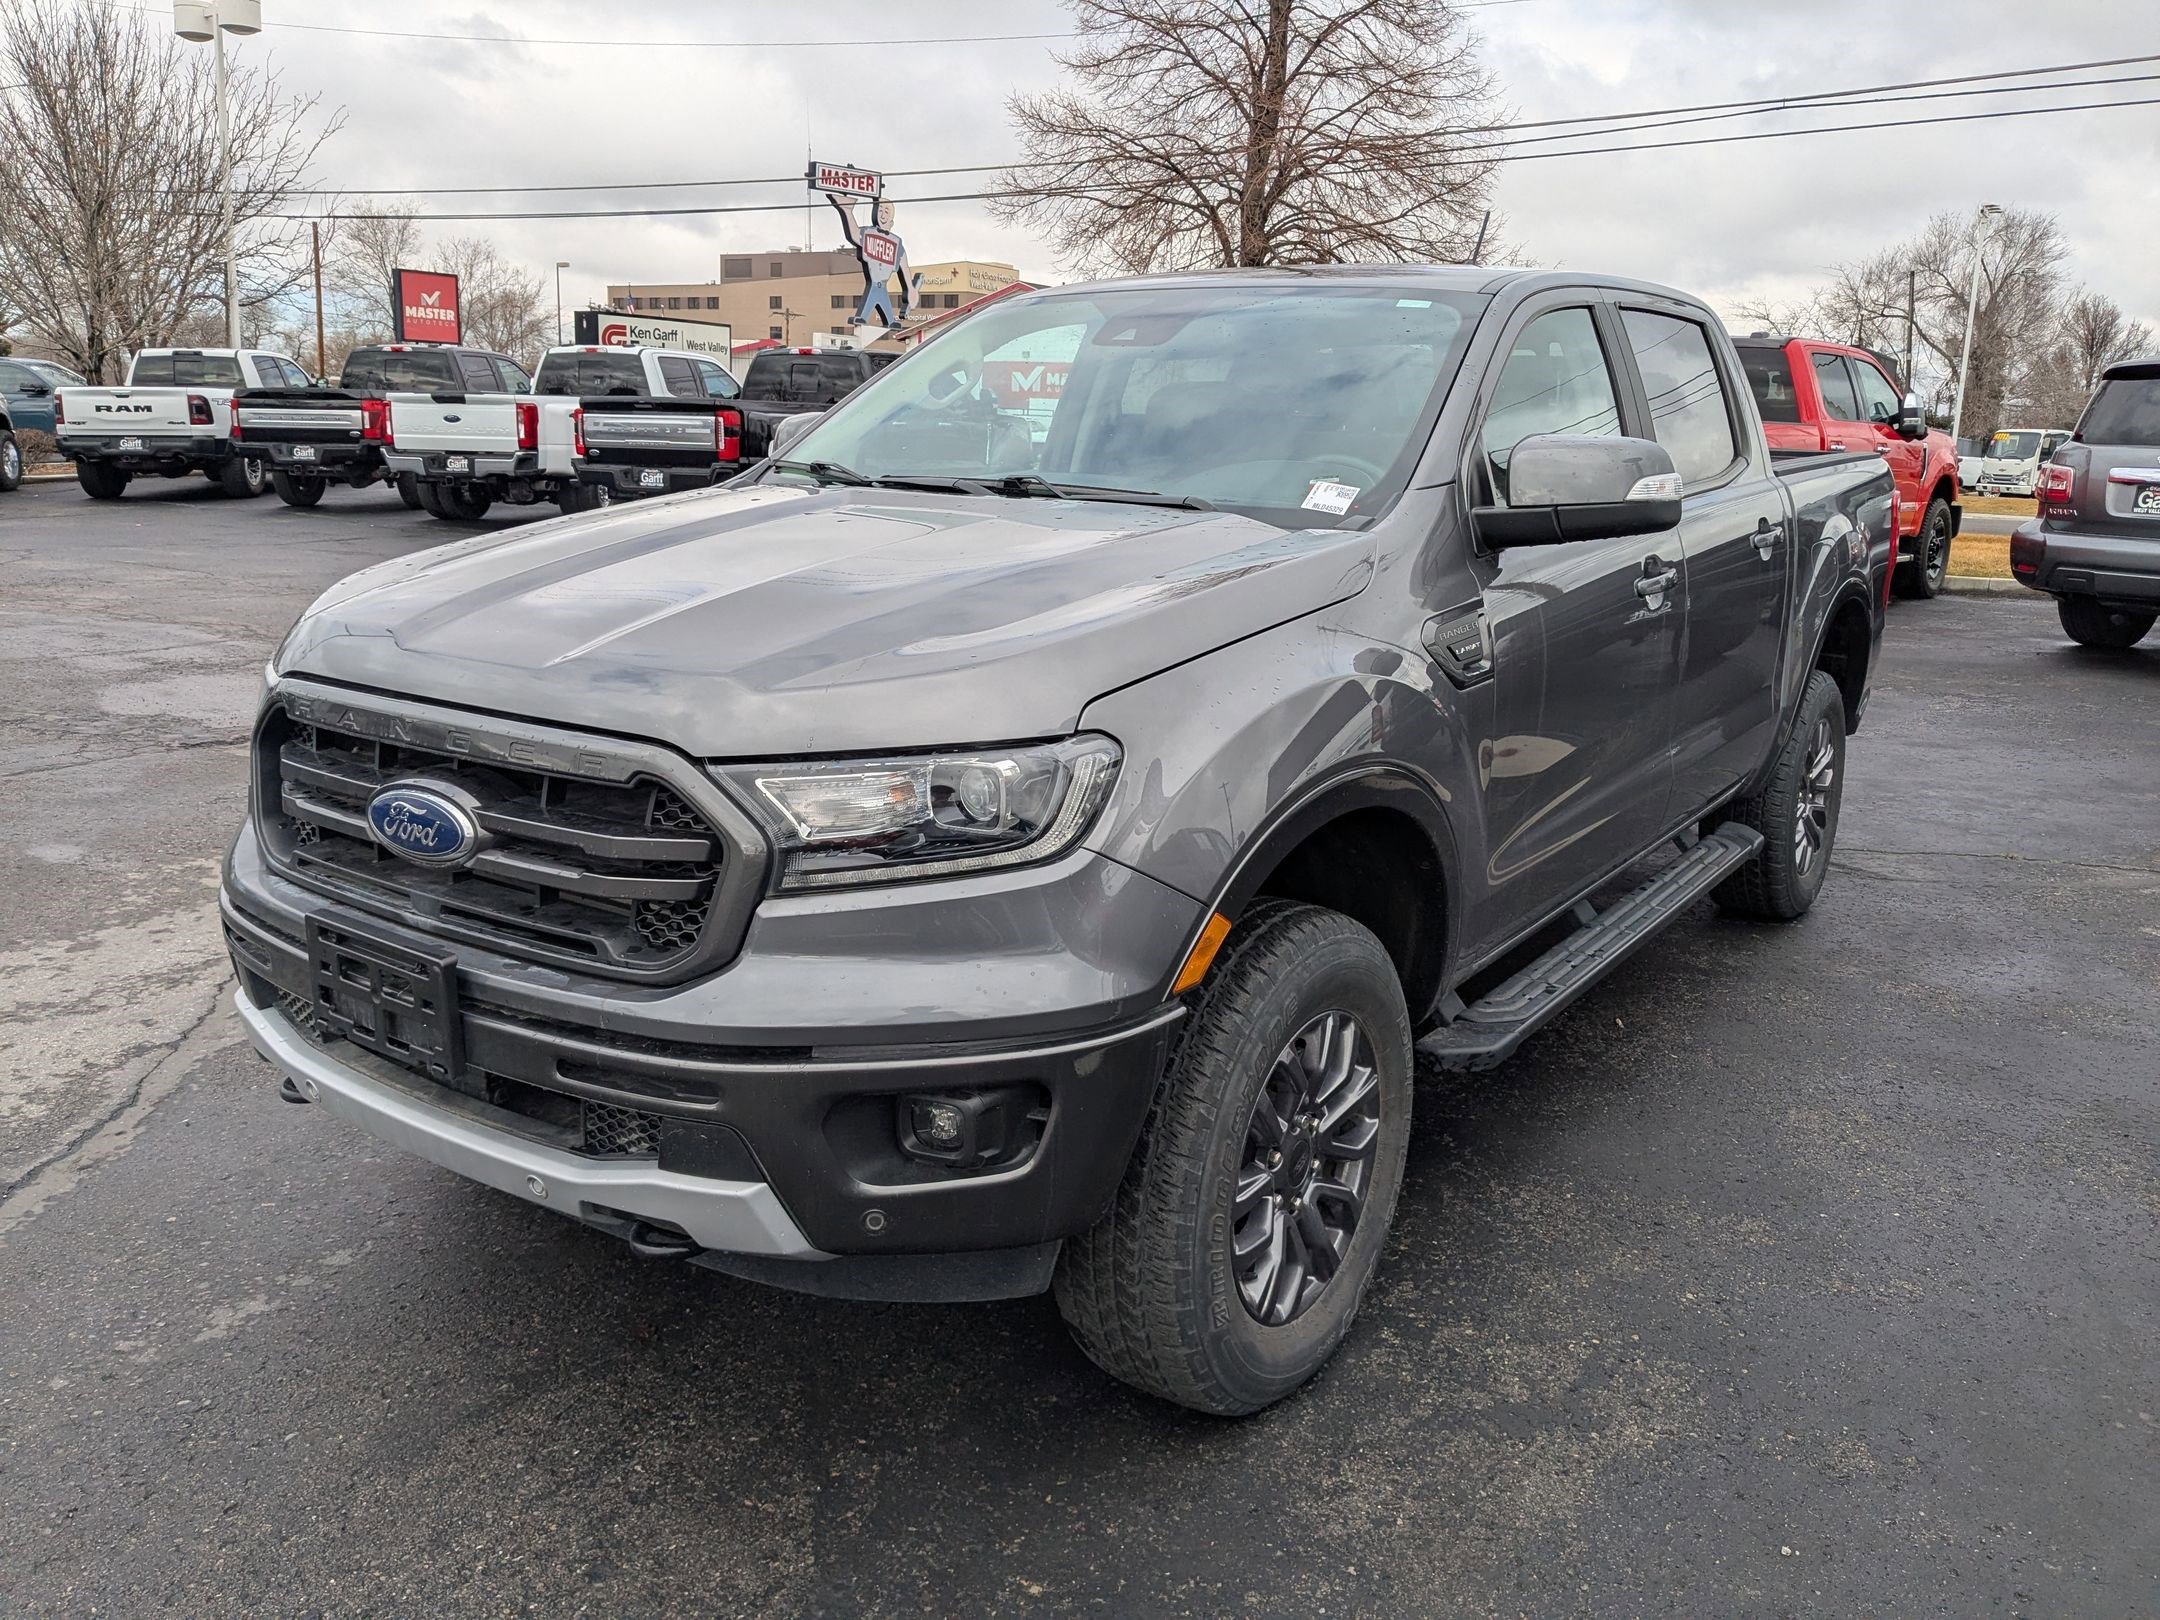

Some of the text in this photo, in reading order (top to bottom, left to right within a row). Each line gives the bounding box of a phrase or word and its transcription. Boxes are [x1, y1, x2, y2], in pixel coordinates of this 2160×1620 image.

[821, 168, 875, 192] MASTER
[866, 235, 894, 261] MUFFLER
[405, 305, 455, 321] MASTER
[629, 325, 678, 342] Ken Garff
[686, 339, 729, 355] West Valley
[95, 405, 153, 413] RAM
[293, 447, 315, 457] Garff
[446, 458, 469, 469] Garff
[640, 472, 664, 483] Garff
[1439, 621, 1479, 641] RANGER
[294, 699, 608, 776] RANGER
[383, 801, 441, 847] Ford
